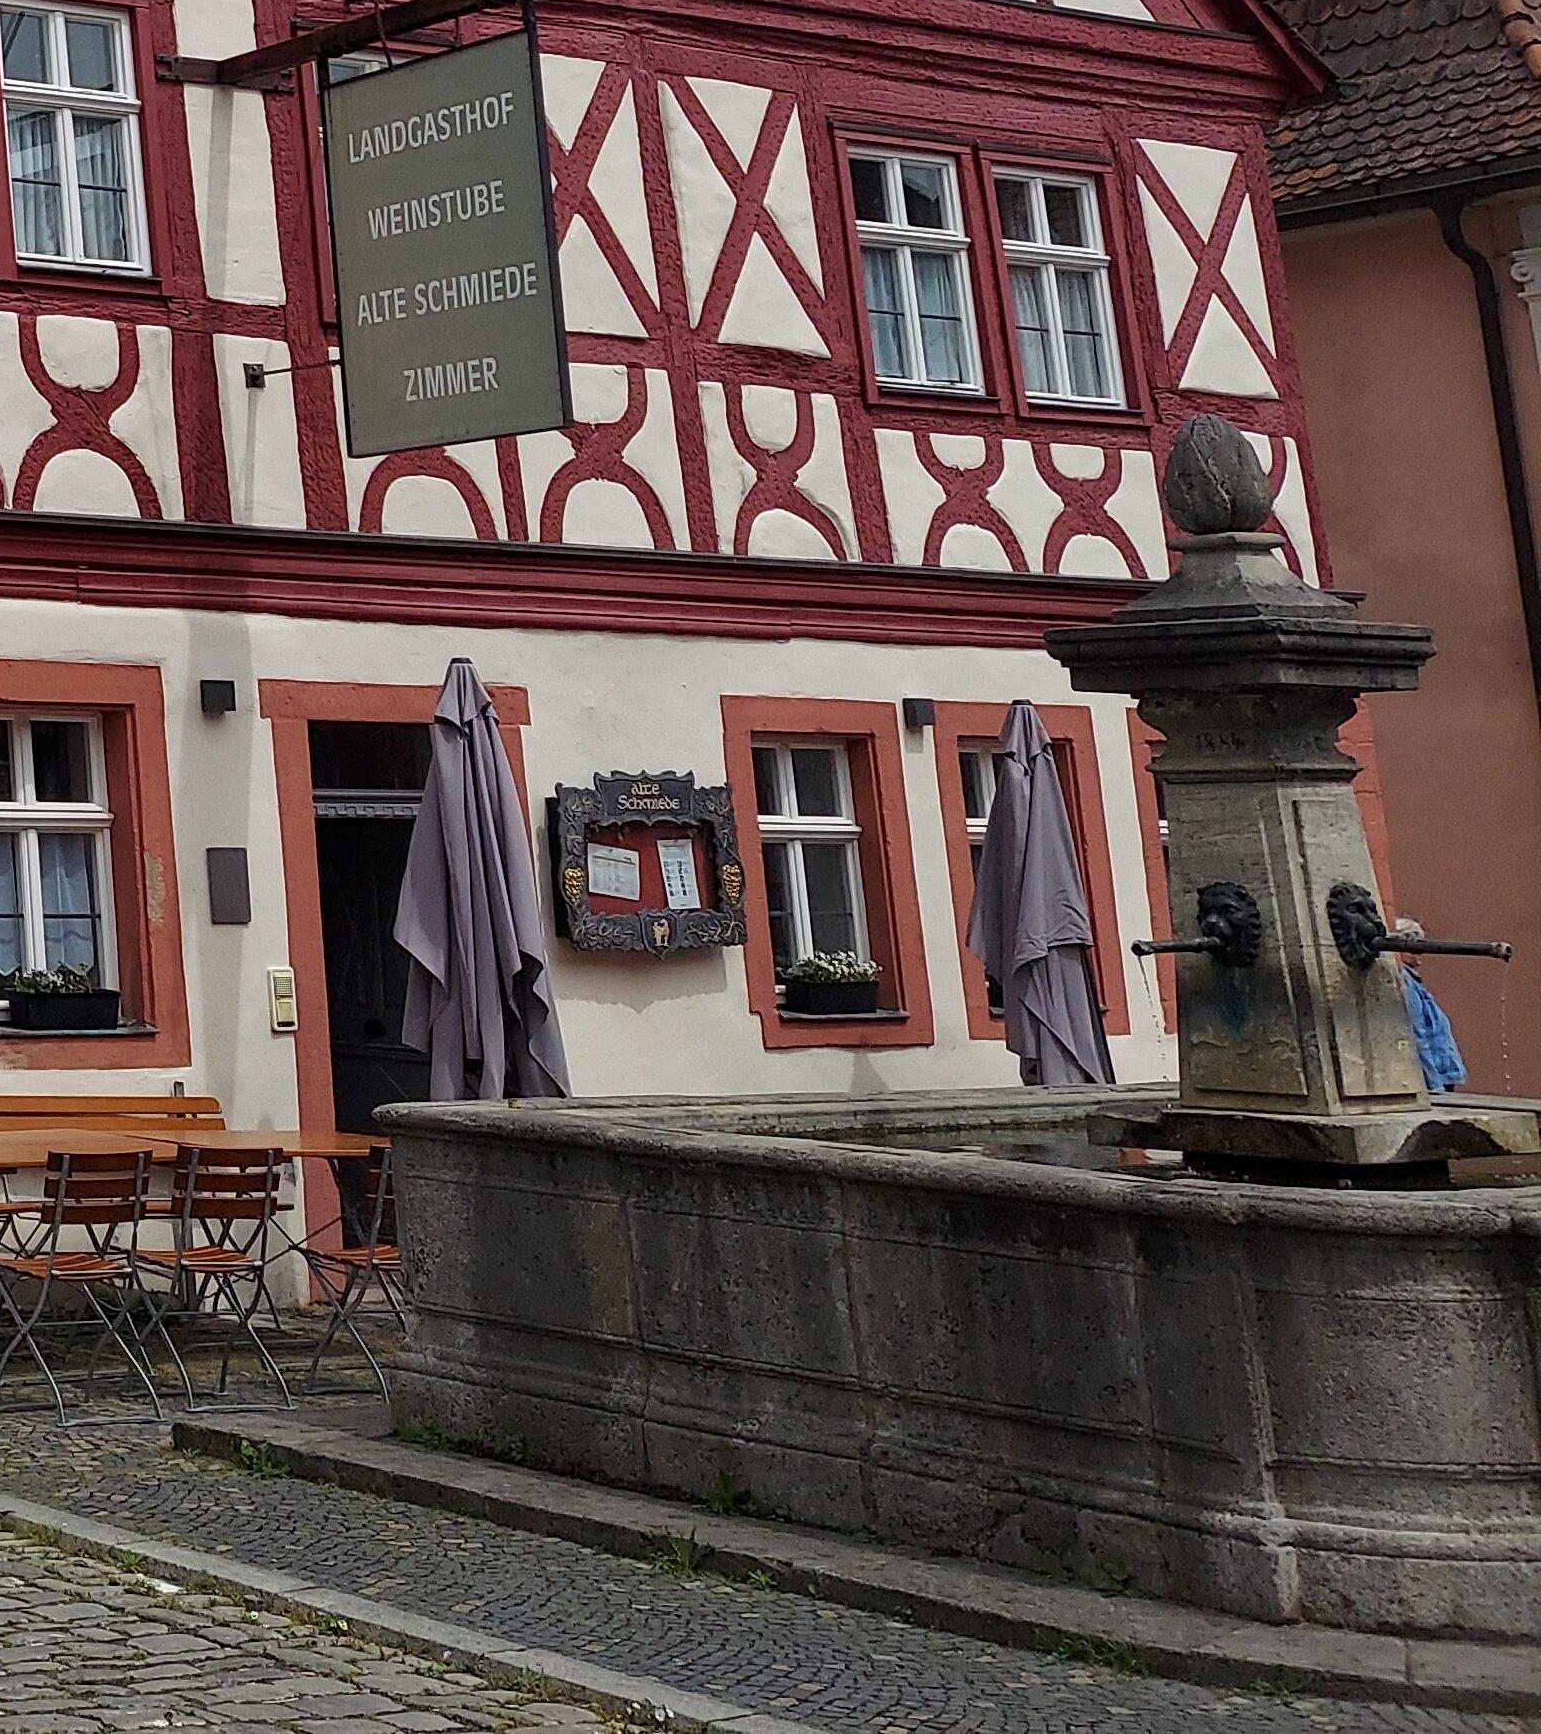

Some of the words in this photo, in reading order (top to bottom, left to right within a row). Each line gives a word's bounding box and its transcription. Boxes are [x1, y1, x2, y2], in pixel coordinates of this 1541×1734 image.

[348, 91, 515, 164] LANDGASTHOF
[368, 179, 505, 240] WEINSTUBE
[357, 288, 406, 326] ALTE
[414, 261, 538, 316] SCHMIEDE
[403, 357, 499, 402] ZIMMER
